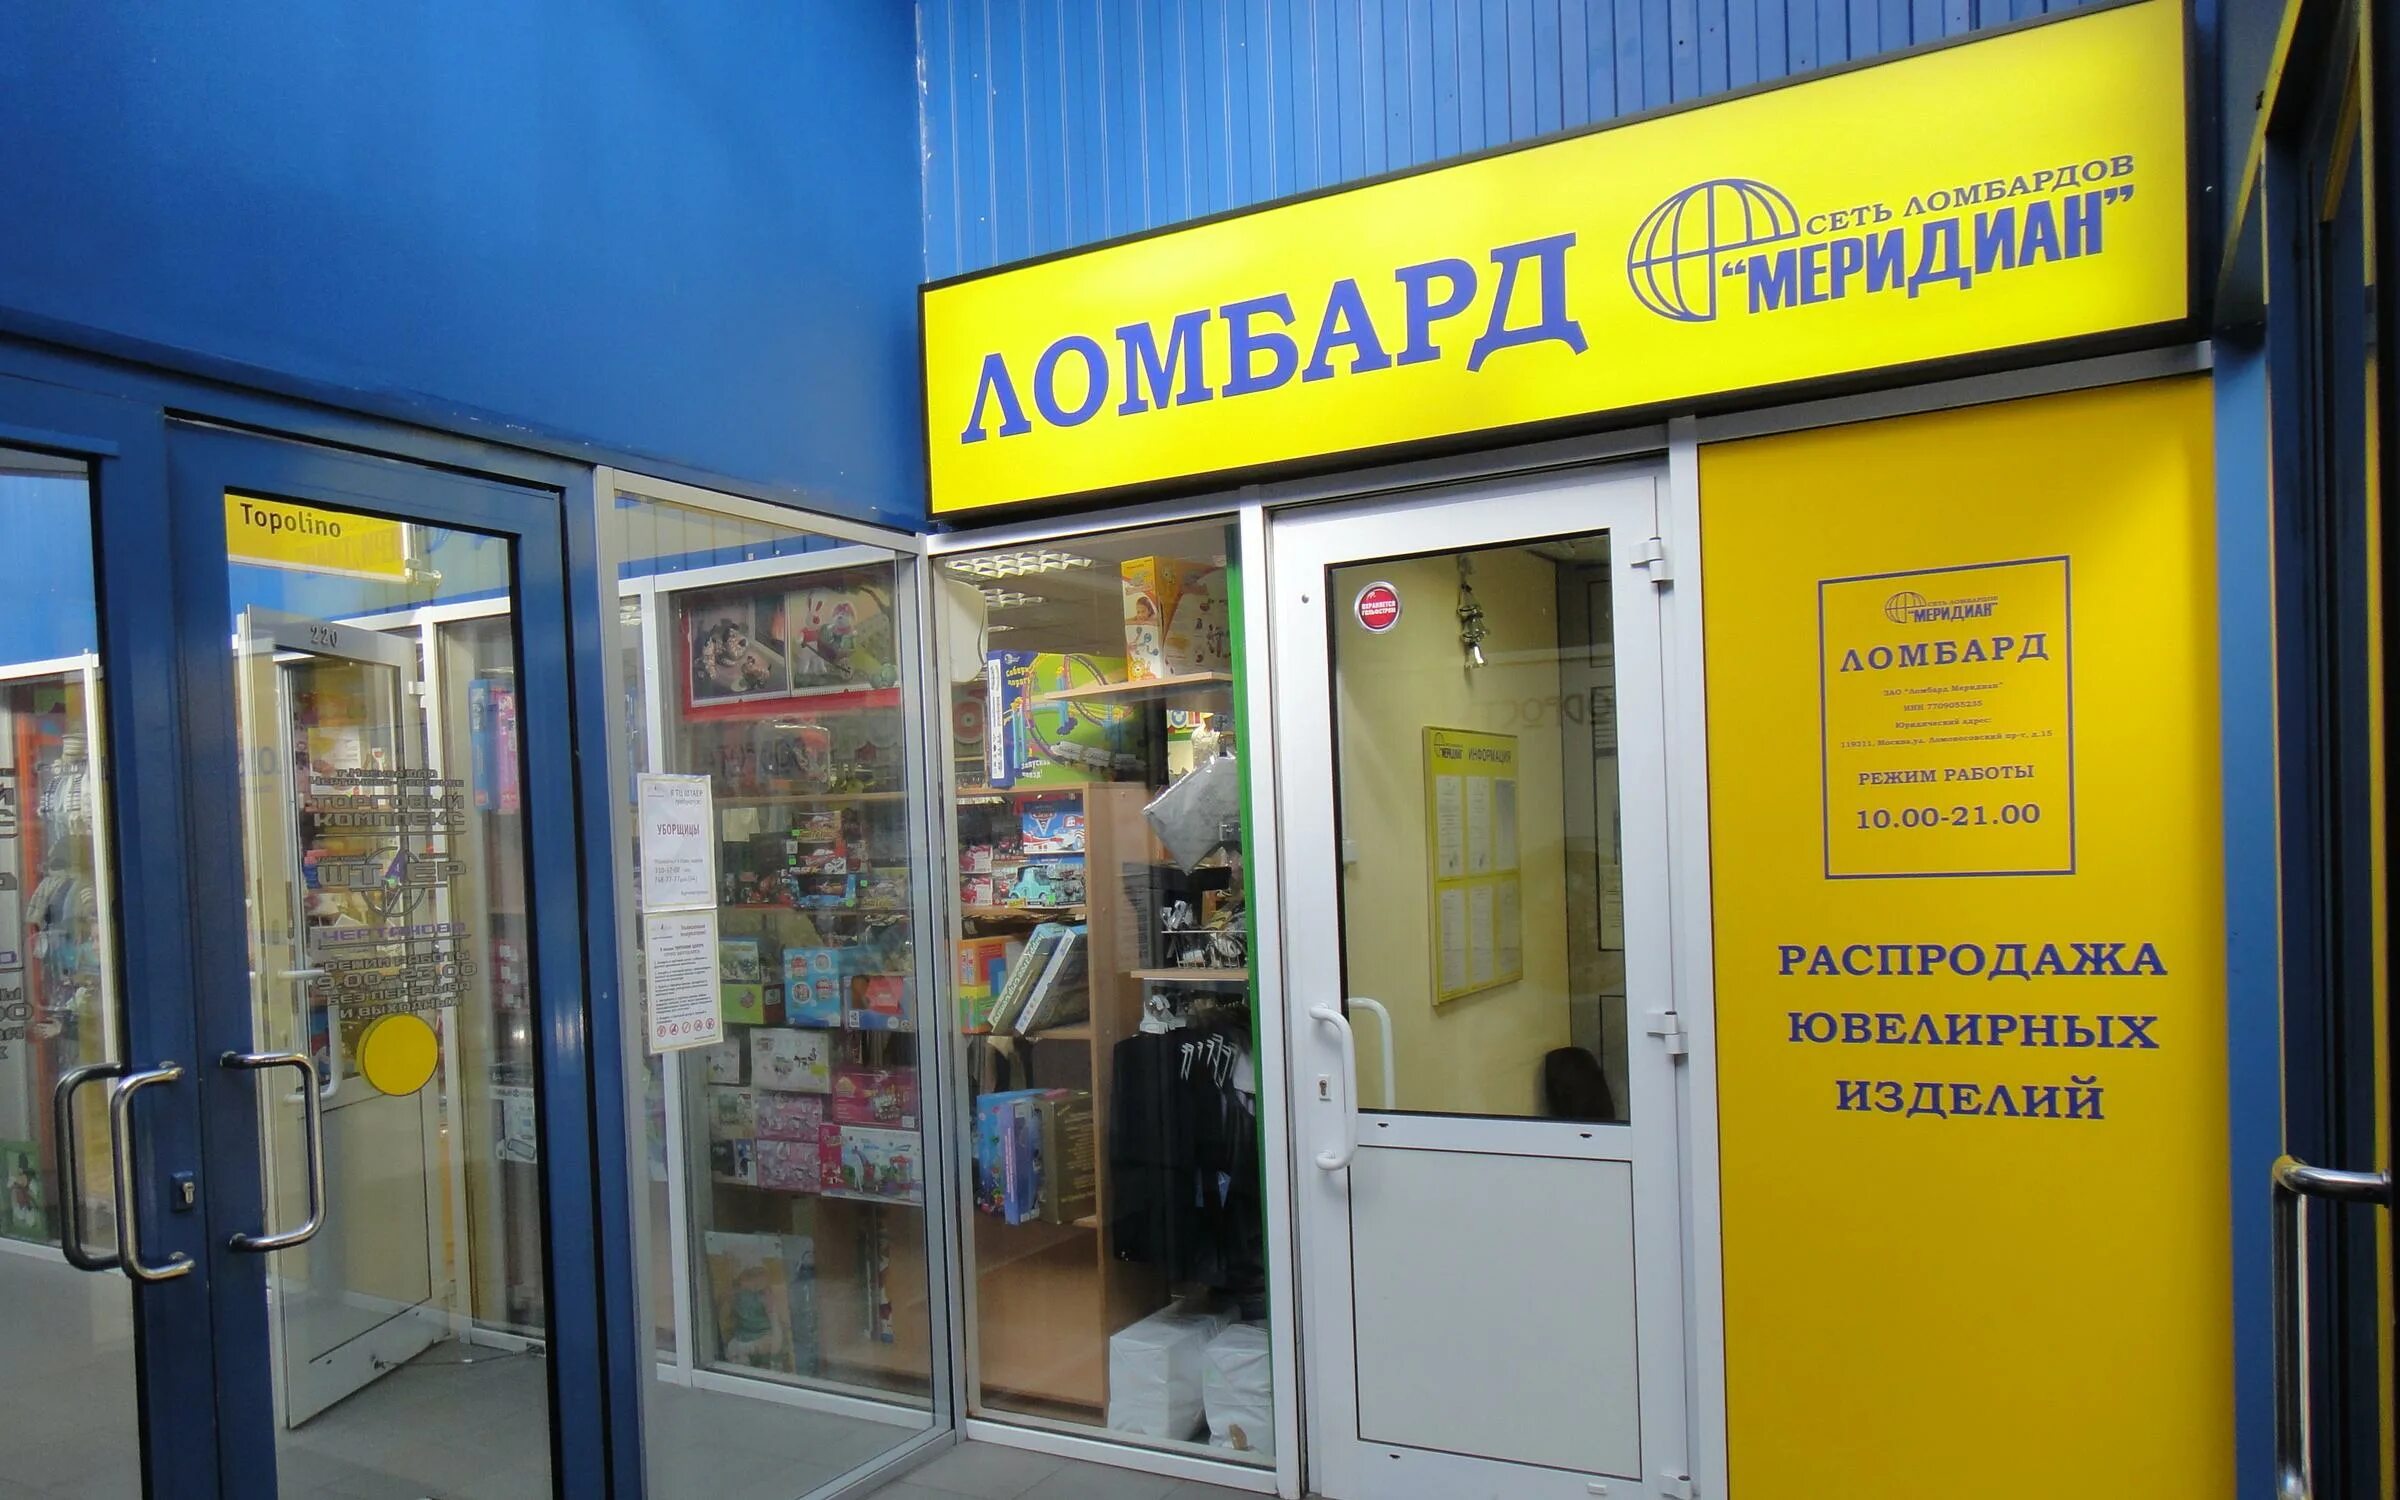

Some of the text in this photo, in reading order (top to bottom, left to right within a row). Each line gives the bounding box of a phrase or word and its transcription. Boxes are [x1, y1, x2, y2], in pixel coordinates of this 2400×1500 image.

[1806, 155, 2136, 235] СЕТЬ ЛОМБАРДОВ
[961, 231, 1589, 445] ЛОМБАРД
[240, 502, 341, 538] Topolino
[310, 624, 338, 648] 220
[1839, 633, 2049, 672] ЛОМБАРД
[1883, 688, 1902, 696] ЗАО
[1904, 703, 1924, 711] ИНН
[1895, 718, 1960, 729] Юридический
[1858, 764, 2035, 786] РЕЖИМ РАБОТЫ
[311, 792, 465, 810] ТОРГОВЫЙ
[312, 811, 465, 827] КОМПЛЕКС
[1857, 802, 2041, 829] 10.00-21.00
[657, 823, 700, 836] УБОРЩИЦЫ
[1777, 943, 2168, 981] РАСПРОДАЖА
[1788, 1012, 2160, 1049] ЮВЕЛИРНЫХ
[1835, 1075, 2105, 1120] ИЗДЕЛИЙ
